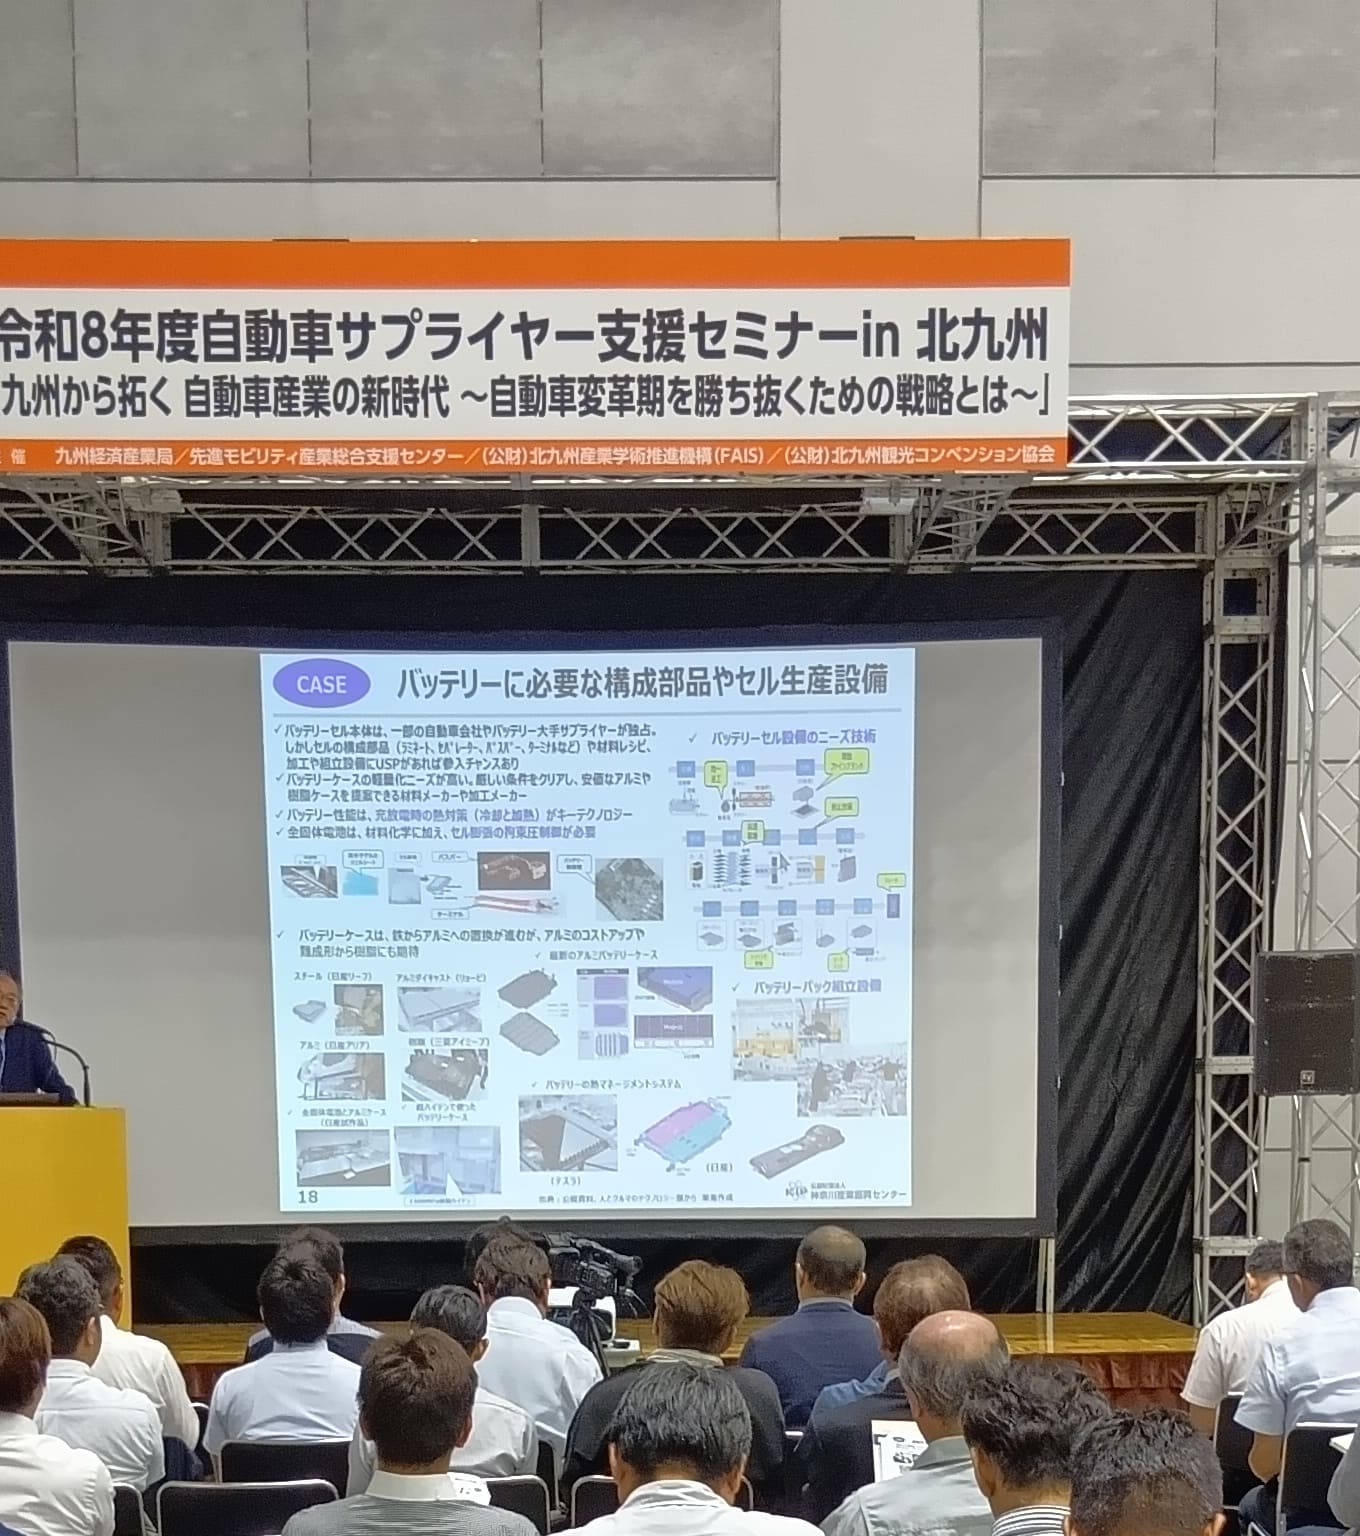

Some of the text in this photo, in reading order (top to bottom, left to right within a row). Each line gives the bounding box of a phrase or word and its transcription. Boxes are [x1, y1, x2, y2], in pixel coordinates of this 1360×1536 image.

[916, 305, 1049, 363] 北九州
[184, 373, 450, 420] 自動車産業の新時代
[296, 674, 348, 695] CASE
[397, 663, 889, 700] バッテリーに必要な構成部品やセル生産設備
[712, 728, 877, 746] バッテリーセル設備のニーズ技術
[298, 1190, 319, 1204] 18
